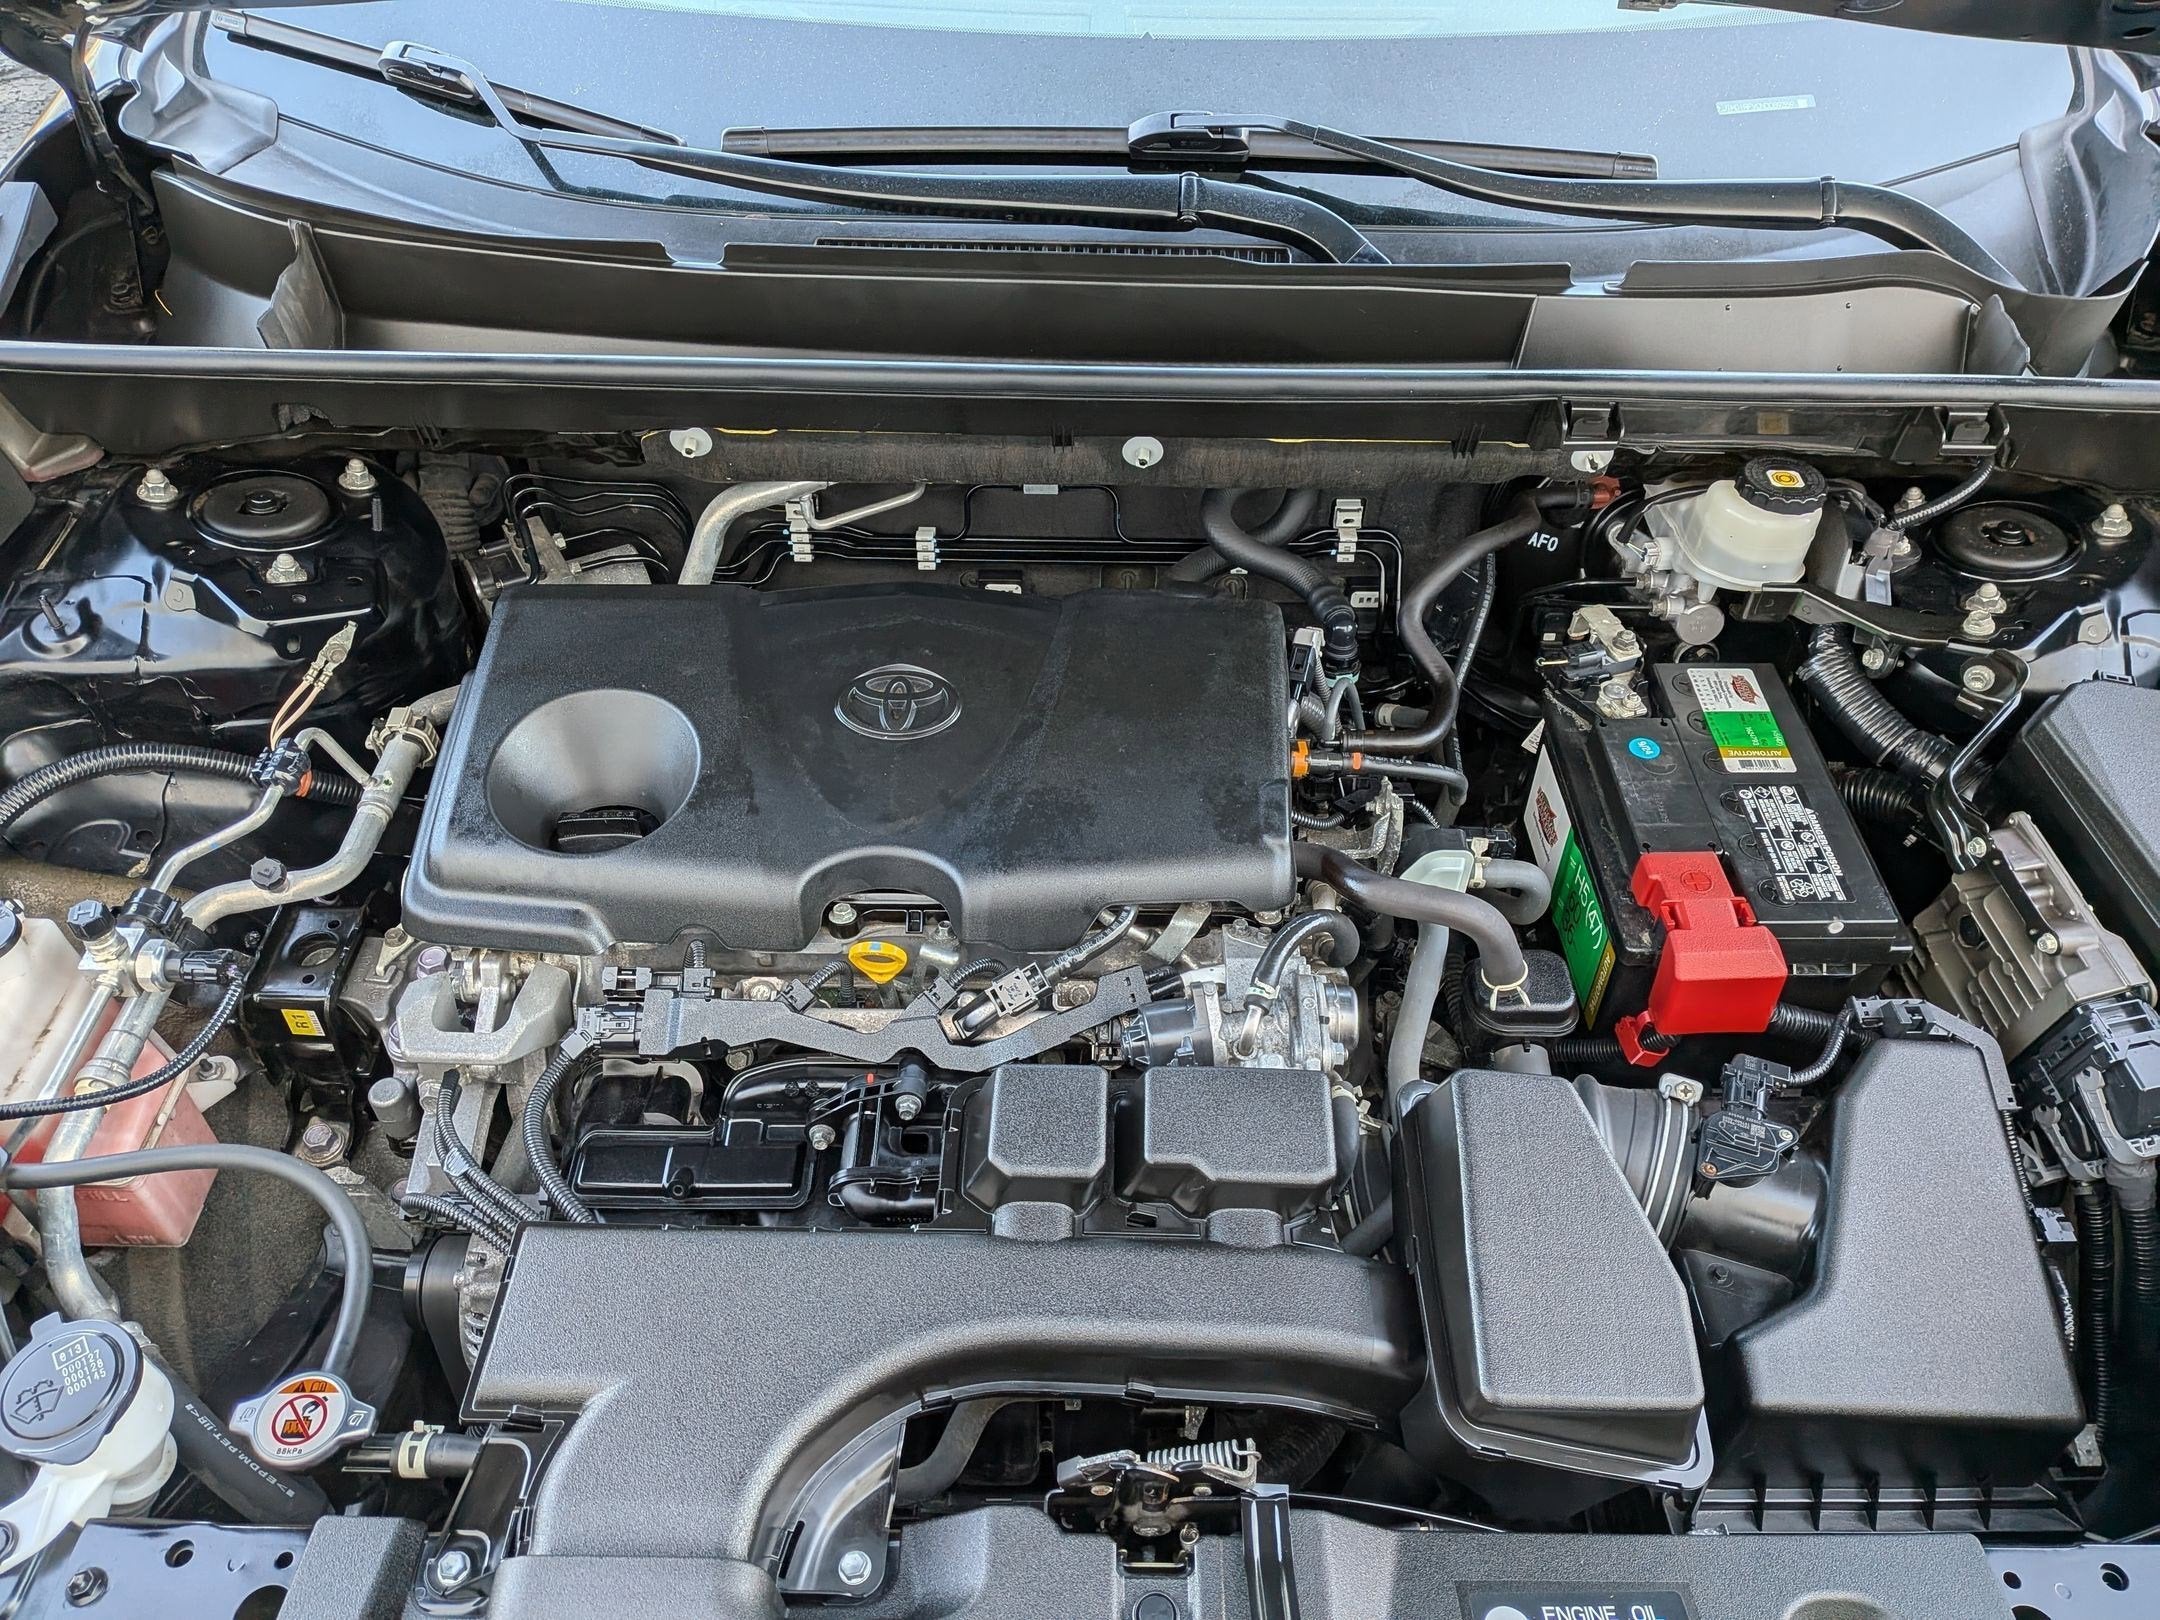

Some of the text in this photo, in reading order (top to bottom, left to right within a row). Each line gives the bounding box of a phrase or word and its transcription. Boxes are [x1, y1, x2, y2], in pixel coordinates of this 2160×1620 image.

[292, 1015, 310, 1029] R1
[61, 1351, 101, 1377] 000127
[64, 1360, 104, 1387] 000128
[66, 1368, 107, 1396] 000145
